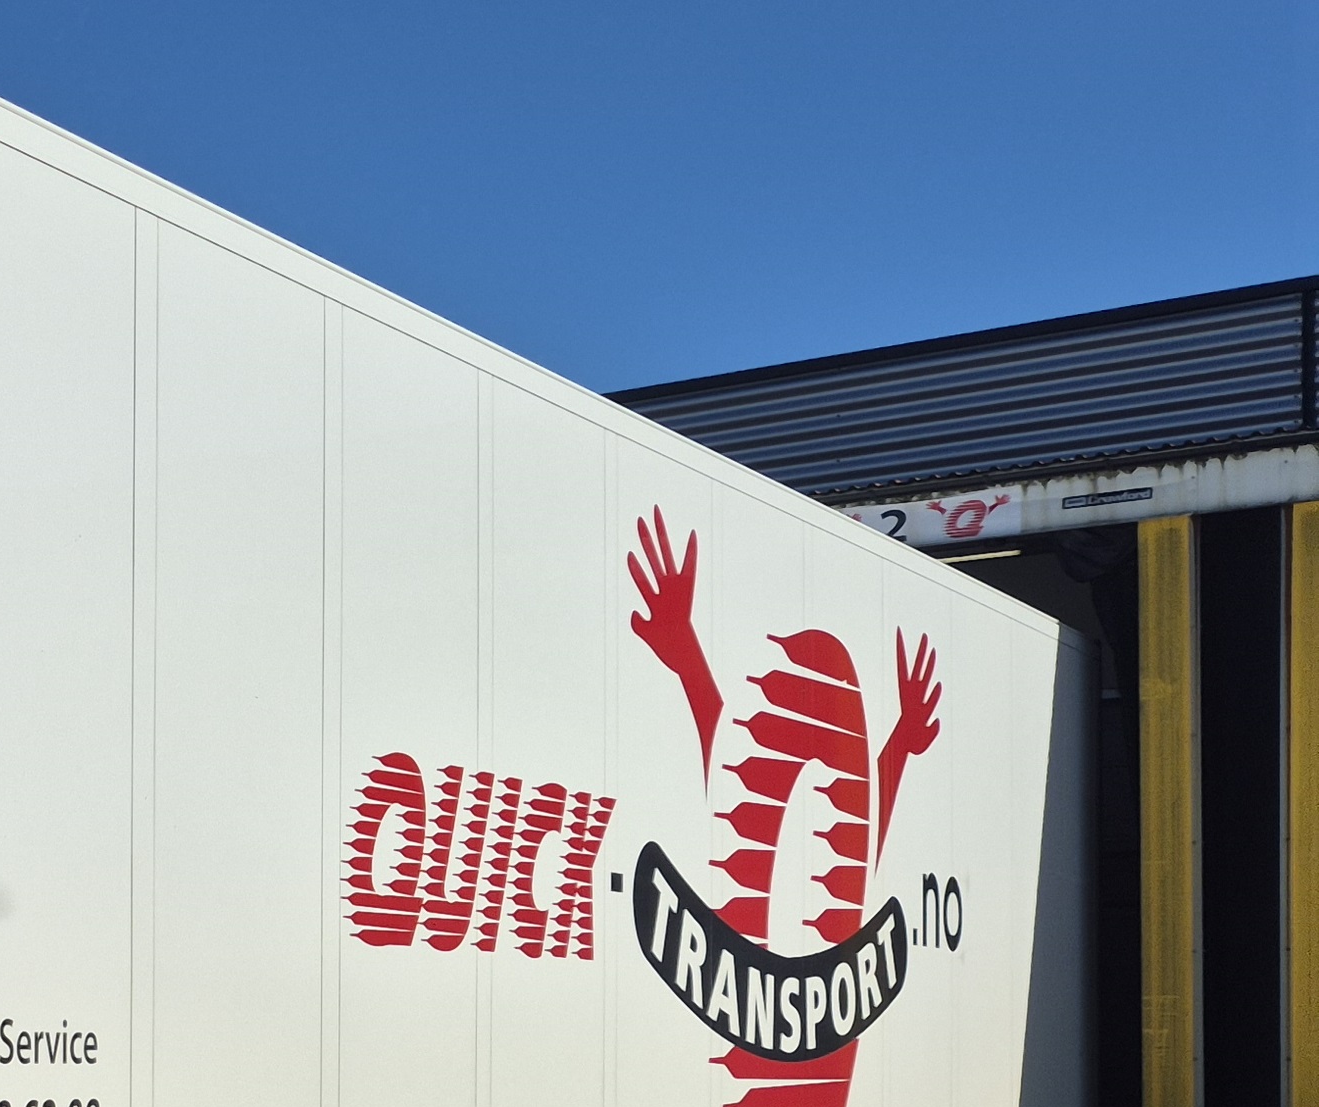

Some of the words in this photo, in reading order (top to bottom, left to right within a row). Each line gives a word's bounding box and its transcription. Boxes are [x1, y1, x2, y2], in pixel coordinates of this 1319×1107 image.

[880, 508, 908, 543] 2
[339, 751, 617, 961] QUICK
[650, 866, 898, 1054] TRANSPORT
[0, 1018, 99, 1065] Service
